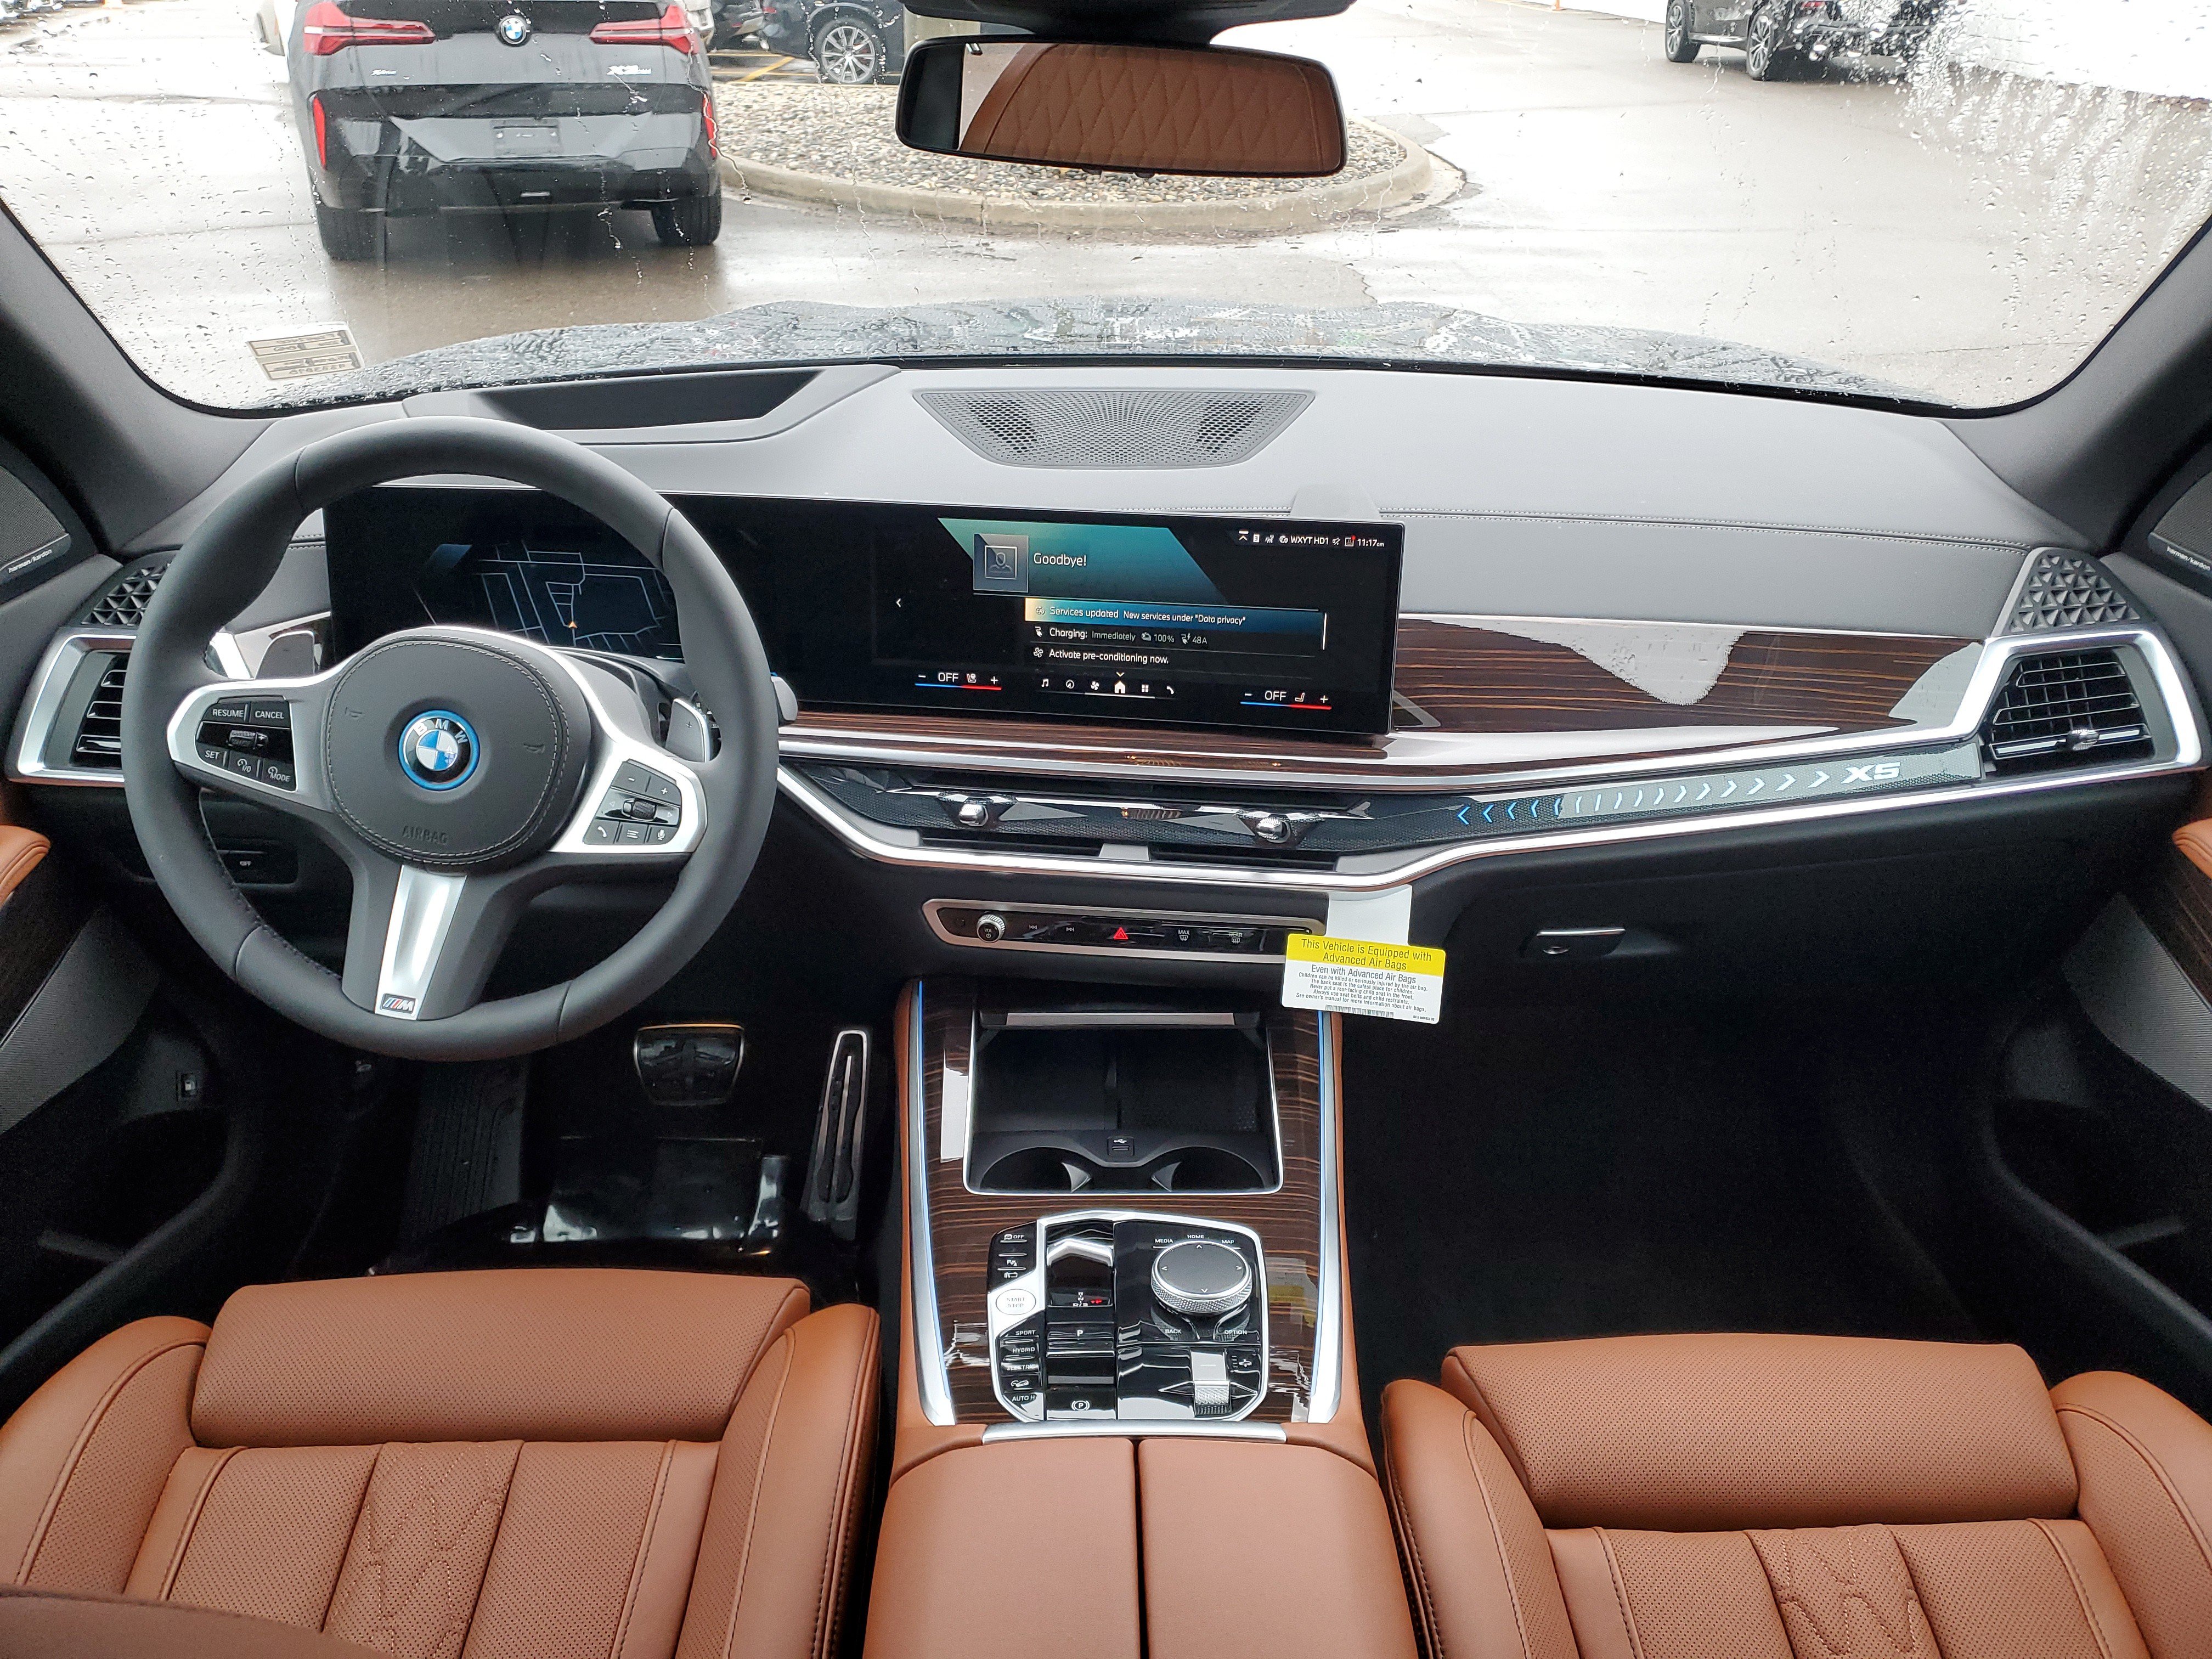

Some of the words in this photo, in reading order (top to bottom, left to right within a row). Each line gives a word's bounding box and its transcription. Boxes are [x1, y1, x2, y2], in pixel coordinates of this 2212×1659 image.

[1290, 535, 1313, 544] WXYT
[1313, 536, 1329, 545] HD1
[1034, 552, 1087, 568] Goodbye!
[1049, 606, 1084, 617] Services
[1085, 608, 1119, 619] updated
[1123, 611, 1140, 619] New
[1141, 612, 1171, 621] services
[1172, 613, 1194, 622] under
[1195, 614, 1215, 623] "Data
[1217, 616, 1246, 626] privacy"
[1049, 628, 1088, 640] Charging:
[1092, 631, 1136, 642] Immediately
[1154, 634, 1175, 643] 100%
[1048, 648, 1082, 659] Activate
[1083, 652, 1148, 664] pre-conditioning
[938, 672, 959, 682] OFF
[1265, 691, 1286, 701] OFF
[212, 709, 244, 718] RESUME
[255, 711, 284, 719] CANCEL
[414, 718, 469, 744] BMW
[205, 750, 220, 760] SET
[270, 772, 291, 782] MODE
[1840, 762, 1901, 784] X5
[402, 825, 448, 845] AIRBAG
[1301, 939, 1319, 949] This
[1323, 941, 1354, 952] Vehicle
[1357, 944, 1364, 953] is
[1368, 946, 1409, 959] Equipped
[1413, 951, 1431, 961] with
[1323, 952, 1366, 966] Advanced
[1369, 957, 1382, 967] Air
[1385, 959, 1407, 971] Bags
[1311, 964, 1328, 974] Even
[1331, 967, 1346, 975] with
[1347, 968, 1384, 980] Advanced
[1385, 973, 1396, 981] Air
[1398, 974, 1416, 985] Bags
